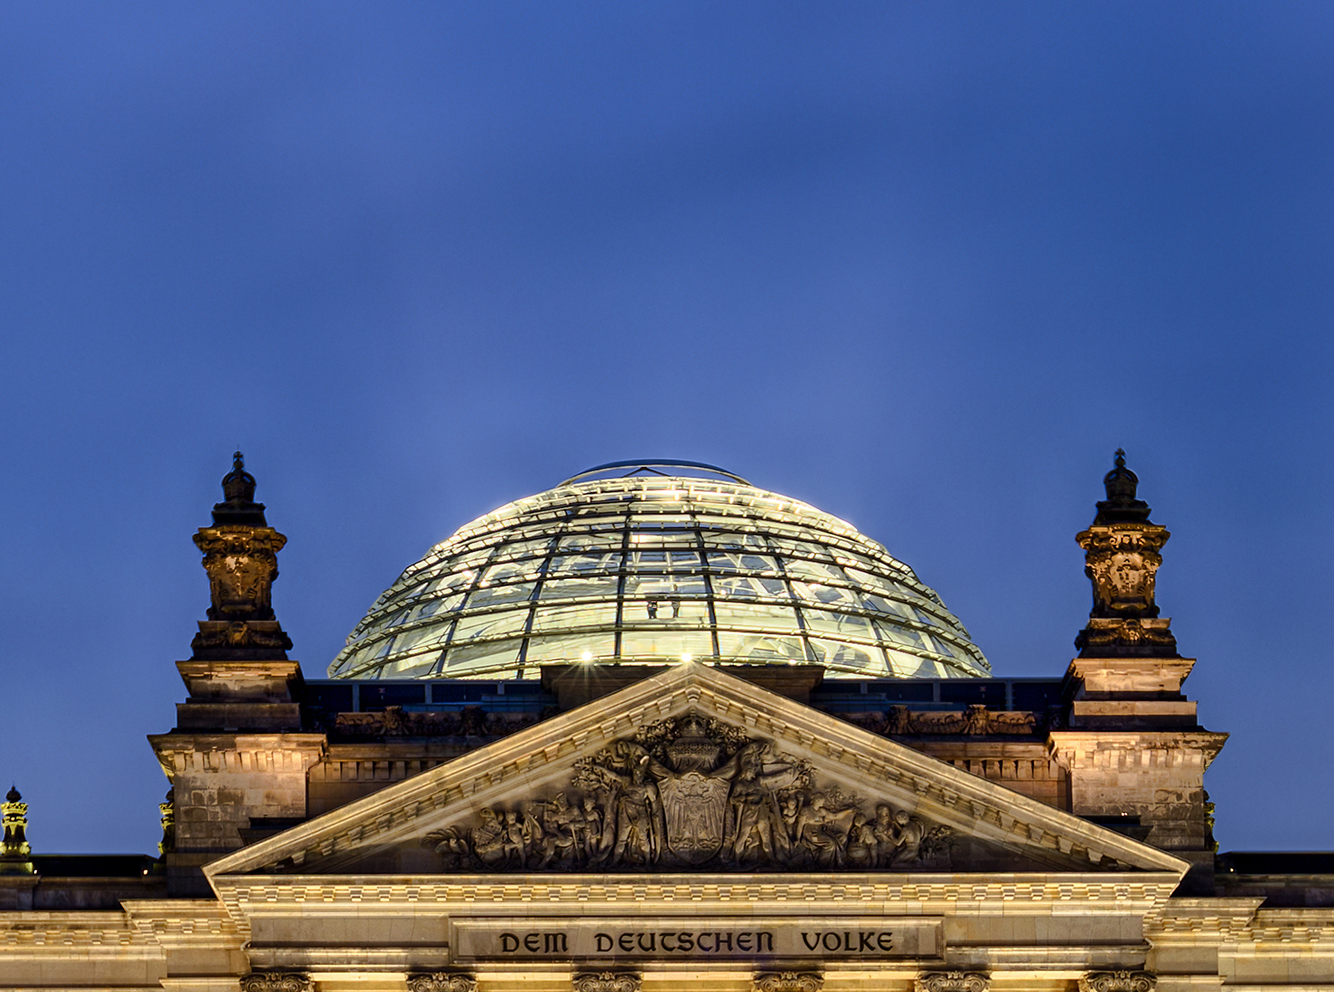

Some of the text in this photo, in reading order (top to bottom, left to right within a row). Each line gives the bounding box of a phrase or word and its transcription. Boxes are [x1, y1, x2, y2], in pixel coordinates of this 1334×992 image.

[499, 932, 895, 953] DEM DEUTSCHEN VOLKE
